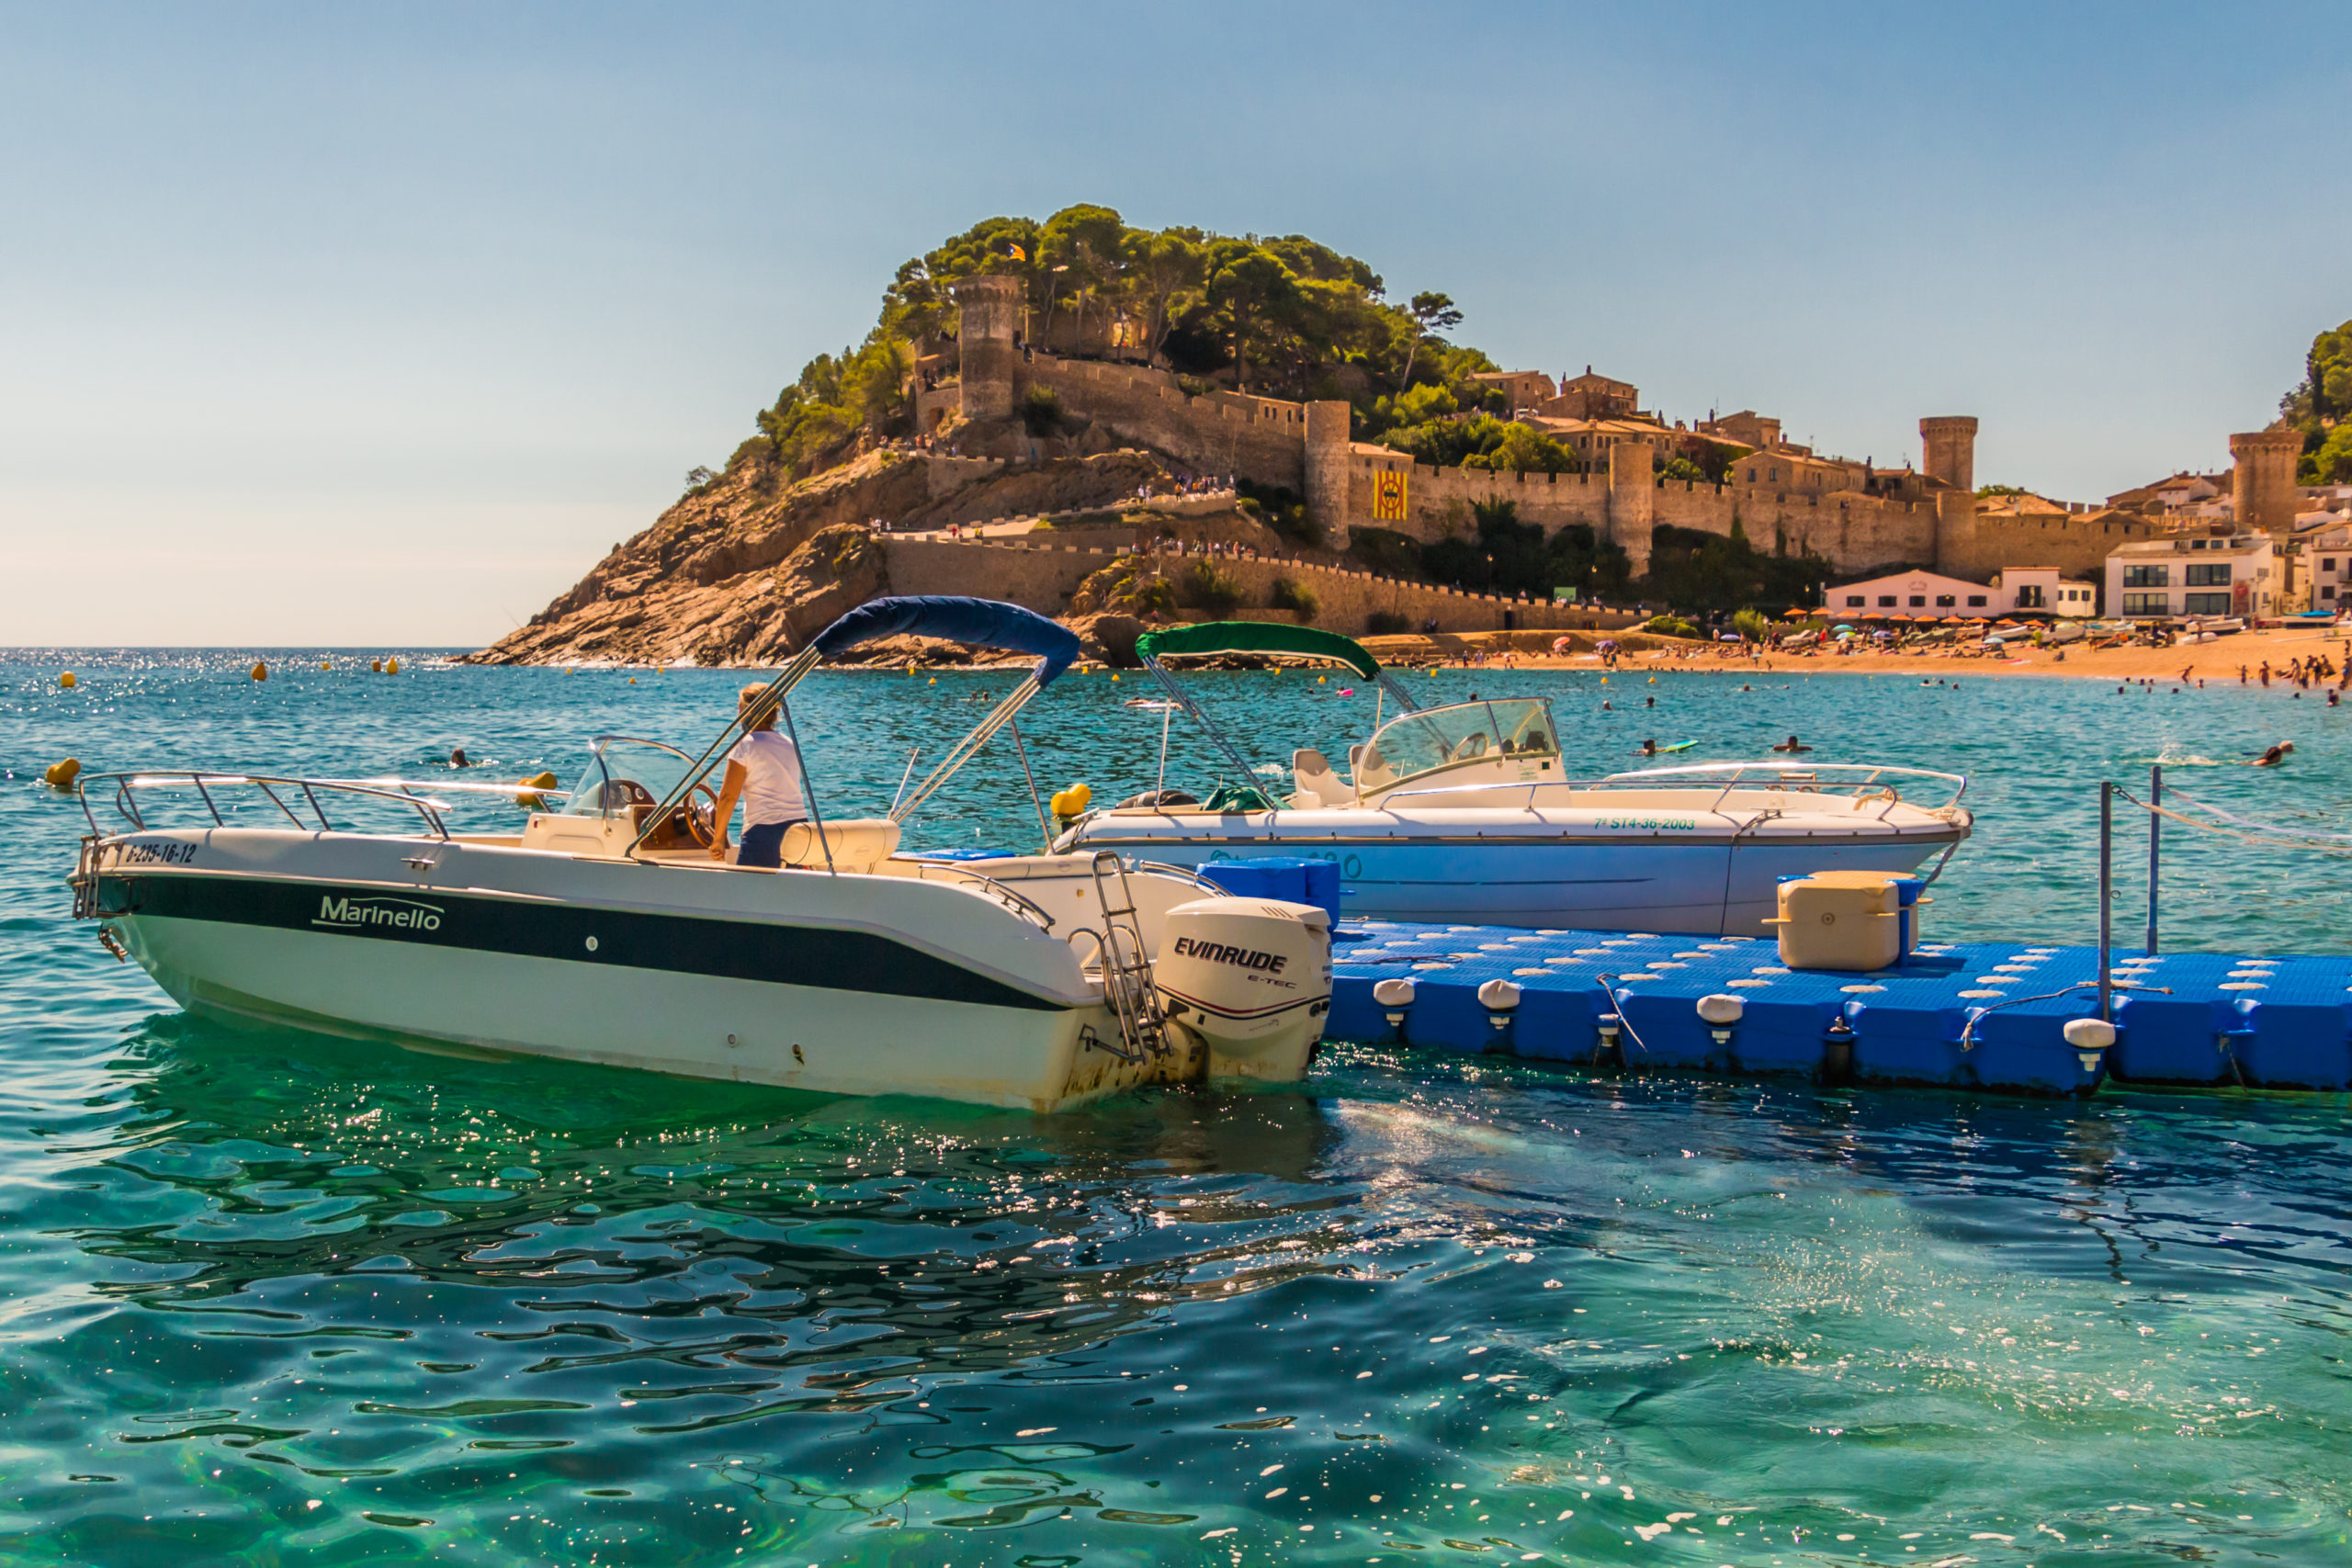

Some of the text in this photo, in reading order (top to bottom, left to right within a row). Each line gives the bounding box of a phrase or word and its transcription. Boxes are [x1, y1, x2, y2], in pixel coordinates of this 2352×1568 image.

[1611, 817, 1696, 830] ST4-36-2003
[320, 896, 441, 931] Marinello
[1174, 937, 1288, 975] EVINRUDE
[1248, 975, 1297, 989] E-TEC
